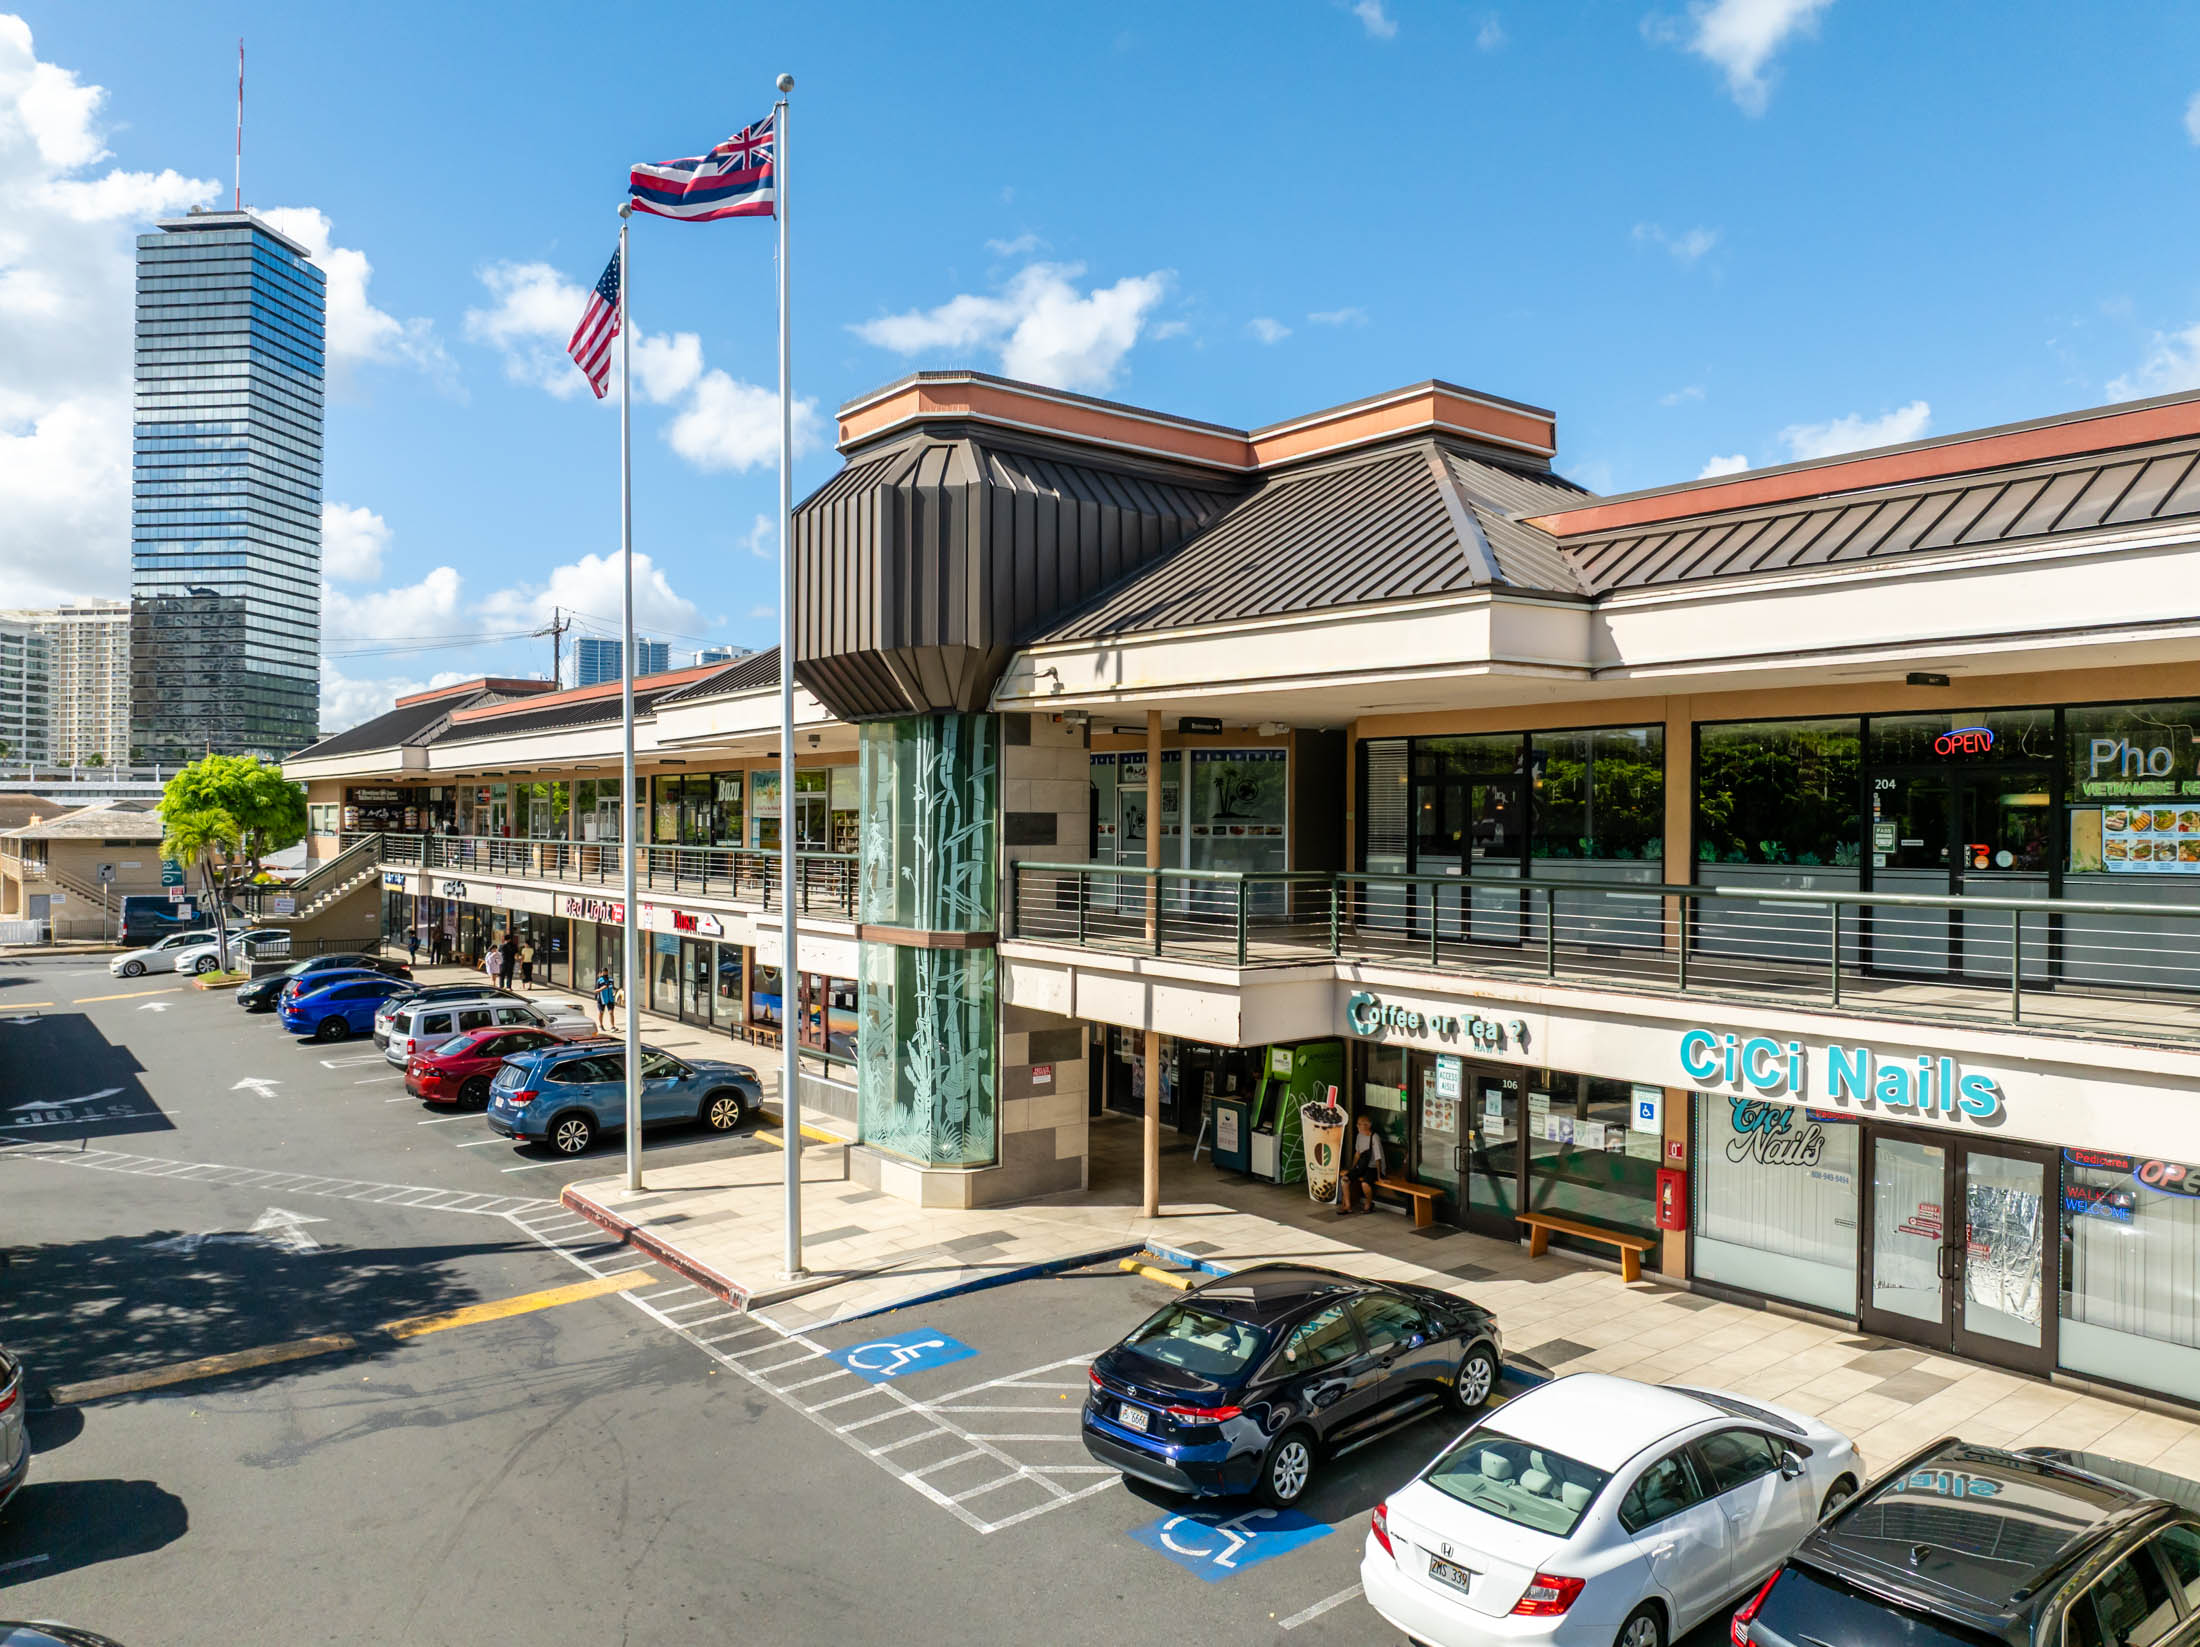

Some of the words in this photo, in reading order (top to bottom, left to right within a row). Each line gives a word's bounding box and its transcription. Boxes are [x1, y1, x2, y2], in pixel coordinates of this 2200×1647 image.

[1934, 733, 1991, 755] OPEN
[2090, 738, 2173, 777] Pho
[1875, 779, 1896, 789] 204
[2082, 781, 2176, 797] VIETNAMESE
[566, 897, 582, 916] Red
[585, 899, 611, 922] Light
[1347, 991, 1419, 1035] Coffee
[1429, 1015, 1454, 1034] or
[1460, 1014, 1498, 1041] Tea
[1439, 1071, 1457, 1082] ACCESS
[1680, 1029, 1803, 1092] CiCi
[1827, 1044, 2000, 1118] Nails
[1441, 1082, 1455, 1092] AISLE
[1503, 1080, 1518, 1089] 106
[1726, 1123, 1825, 1166] Nails
[2075, 1151, 2128, 1169] Pedicures
[2065, 1198, 2129, 1221] WELCOME
[1452, 1568, 1467, 1586] 339
